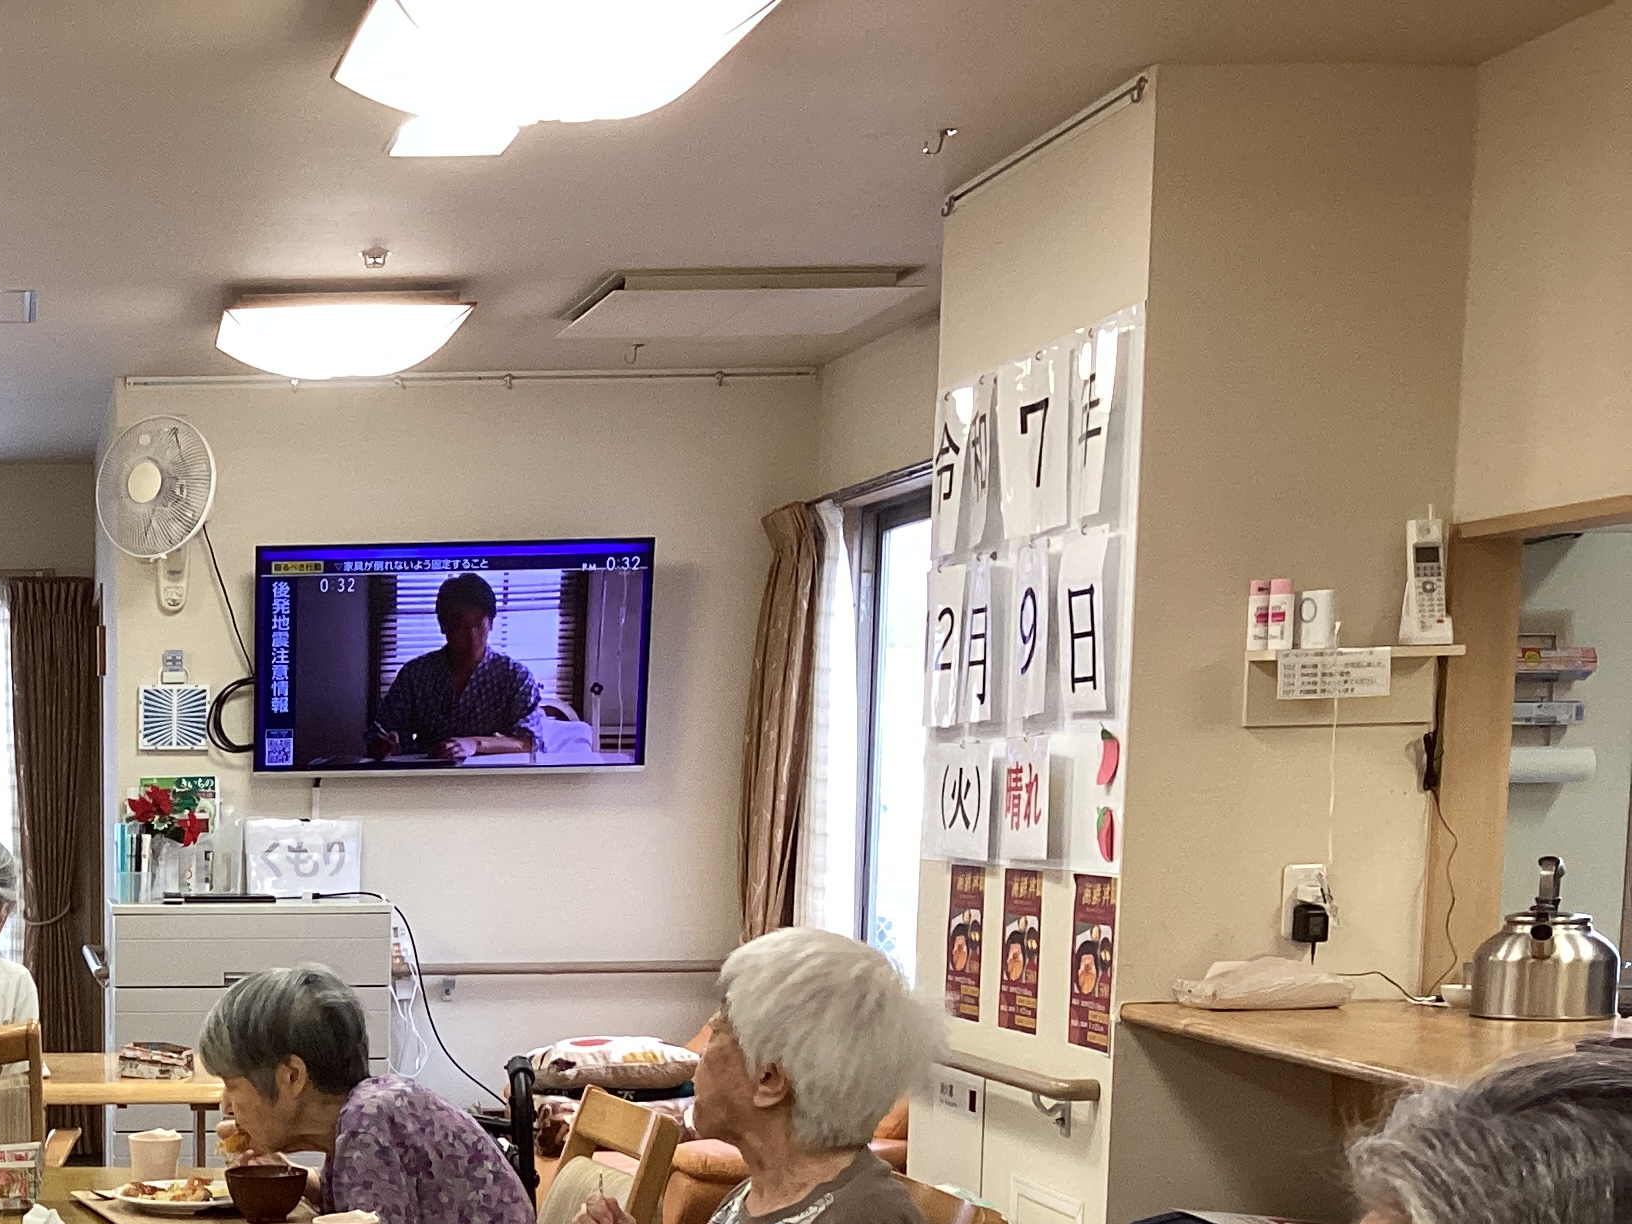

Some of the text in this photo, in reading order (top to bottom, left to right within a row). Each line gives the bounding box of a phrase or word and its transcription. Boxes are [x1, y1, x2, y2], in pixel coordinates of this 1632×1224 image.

[606, 556, 641, 571] 0:32
[319, 578, 355, 593] 0:32
[271, 581, 291, 713] 後発地震注意情報
[1005, 761, 1042, 831] 晴れ
[262, 837, 345, 878] くもり
